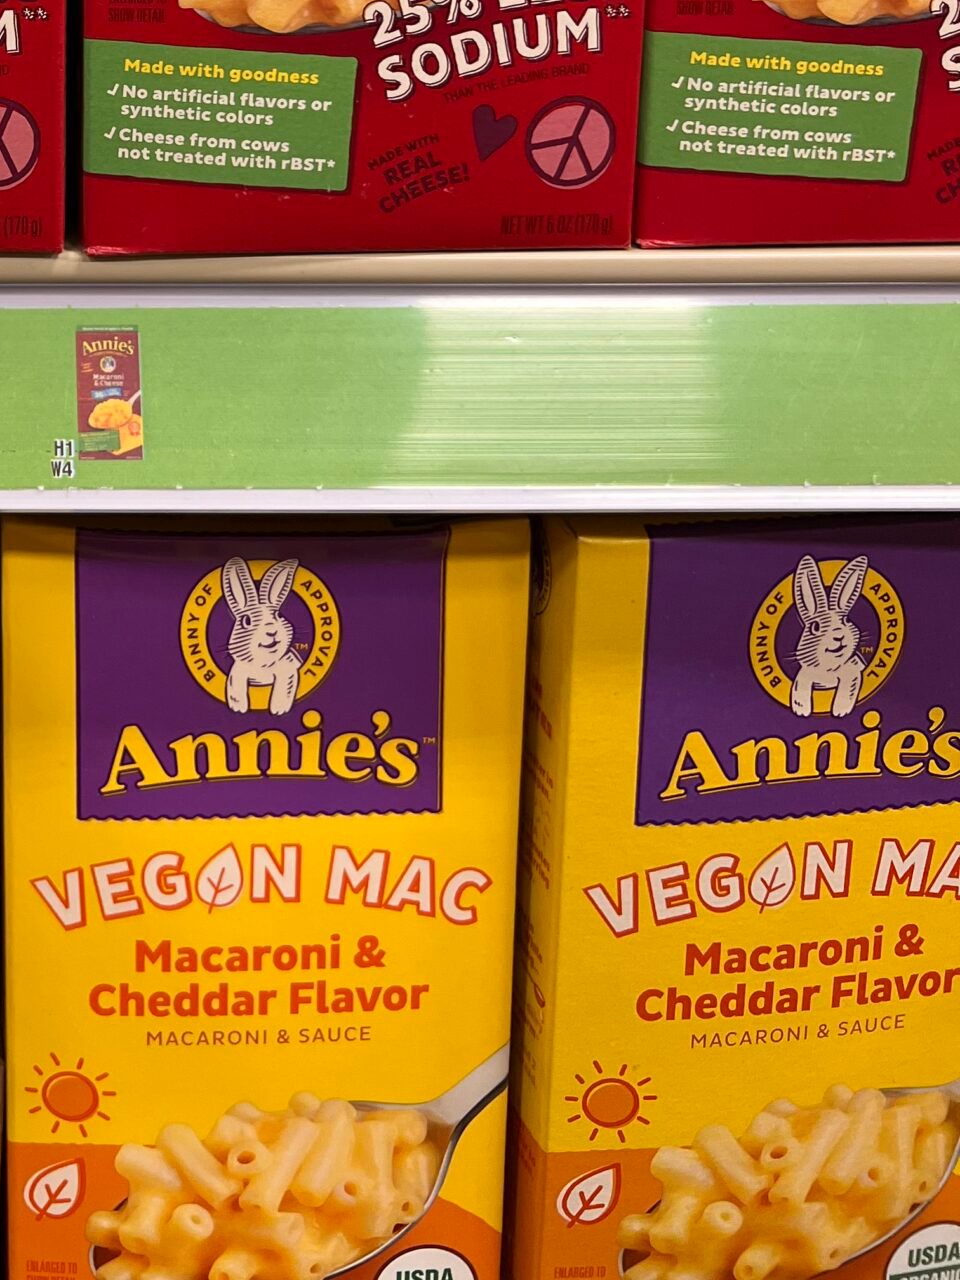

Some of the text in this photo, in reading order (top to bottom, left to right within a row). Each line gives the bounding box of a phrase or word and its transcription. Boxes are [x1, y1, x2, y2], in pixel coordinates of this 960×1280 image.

[83, 337, 134, 355] Annie's
[54, 440, 74, 457] H1
[51, 461, 73, 478] W4
[98, 710, 420, 796] Annie's
[325, 845, 493, 926] MAC
[134, 934, 386, 973] Macaroni &
[89, 981, 429, 1018] Cheddar Flavor
[146, 1026, 372, 1047] MACARONI & SAUCE
